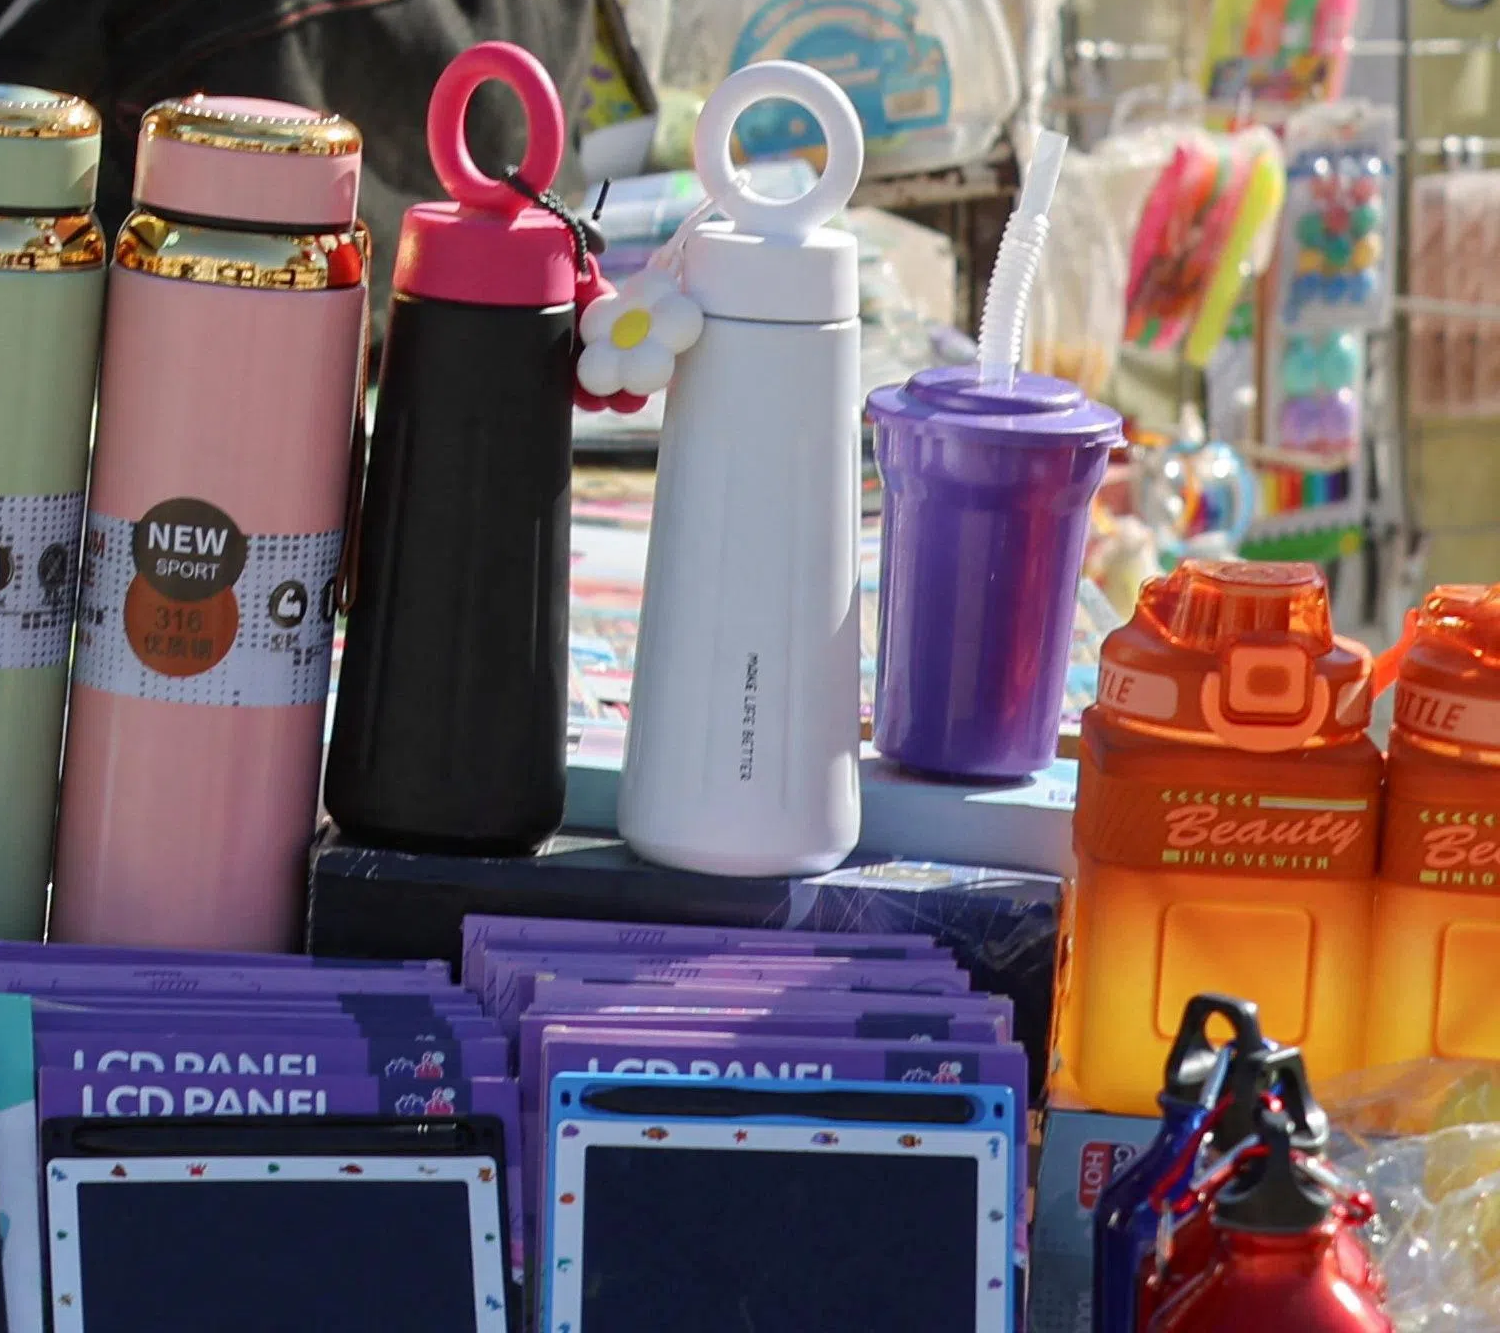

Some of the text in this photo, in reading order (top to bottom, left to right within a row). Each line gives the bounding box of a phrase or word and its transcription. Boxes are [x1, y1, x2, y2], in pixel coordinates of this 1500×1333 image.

[147, 520, 229, 558] NEW
[155, 557, 221, 582] SPORT
[1163, 803, 1364, 856] Beauty
[81, 1084, 175, 1117] LCD
